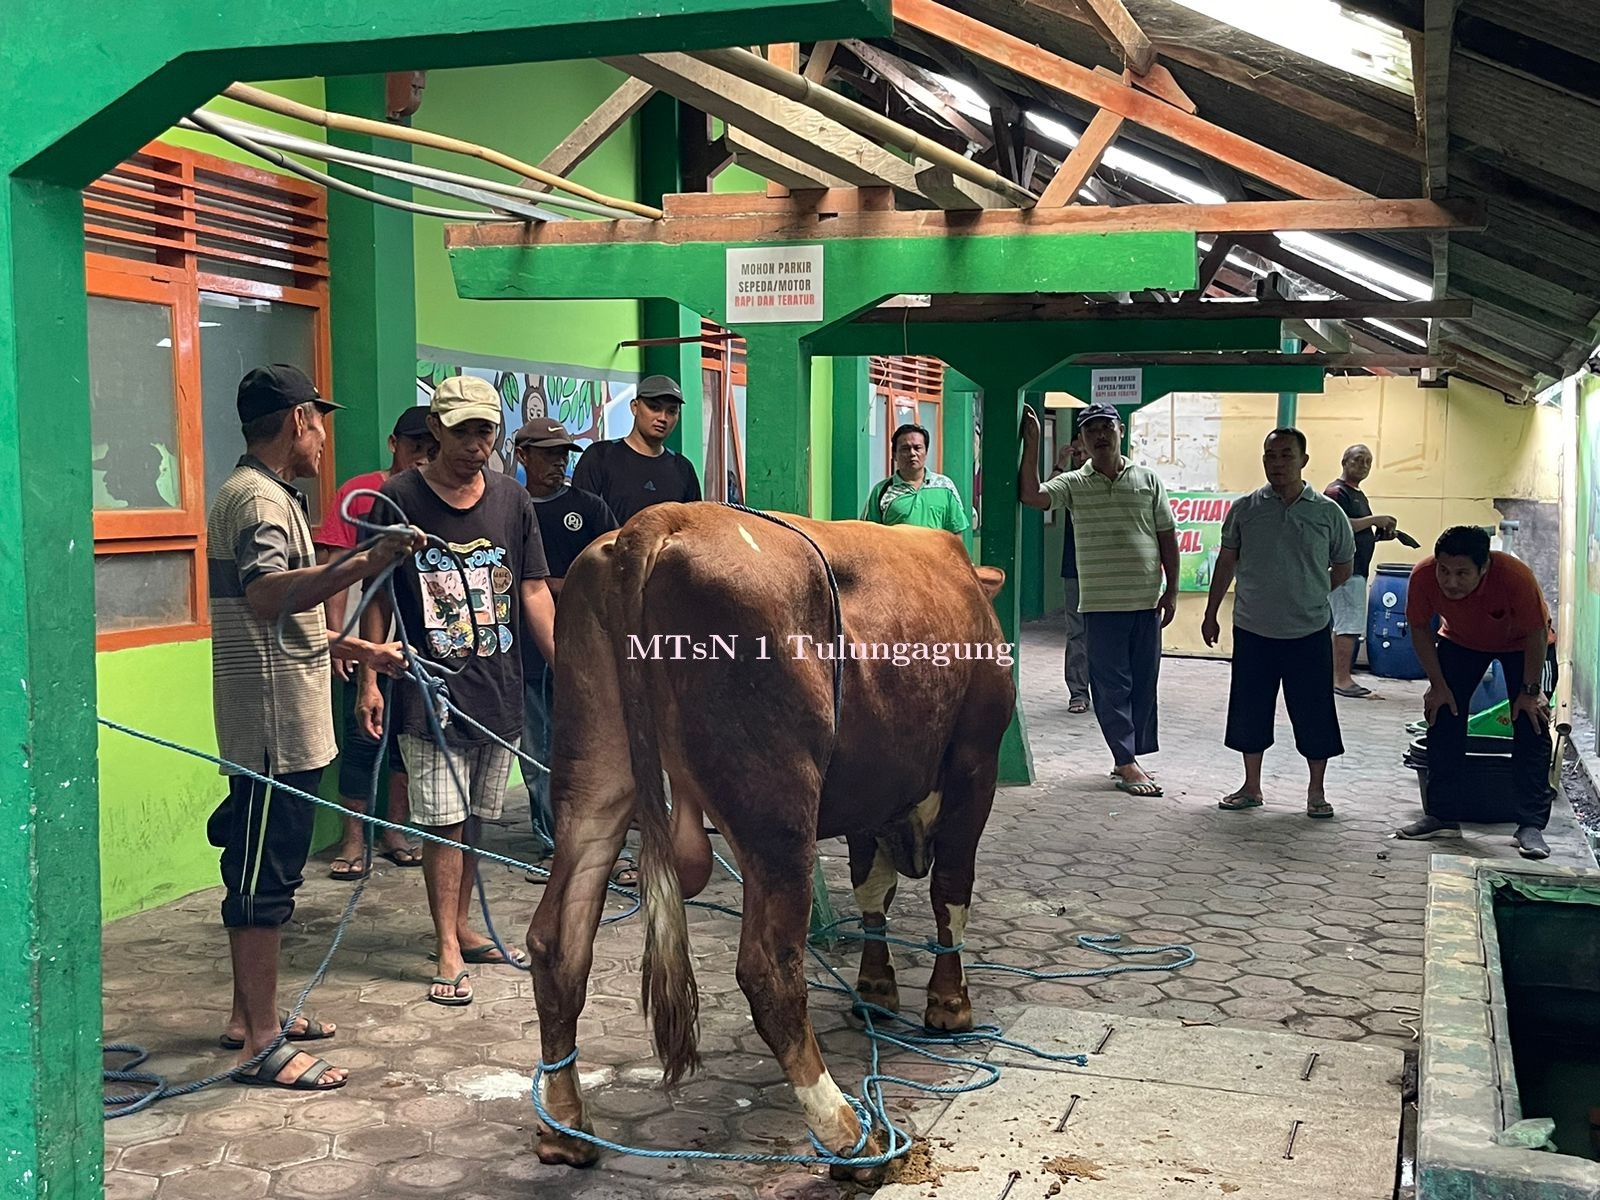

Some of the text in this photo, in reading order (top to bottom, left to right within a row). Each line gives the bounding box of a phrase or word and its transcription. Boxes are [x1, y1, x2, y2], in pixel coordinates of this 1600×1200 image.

[741, 261, 812, 275] MOHON PARKIR
[738, 279, 811, 292] SEPEDA/MOTOR
[734, 293, 815, 307] RAPI DAN TERATUR
[1175, 530, 1202, 552] AL
[465, 547, 506, 571] TONE
